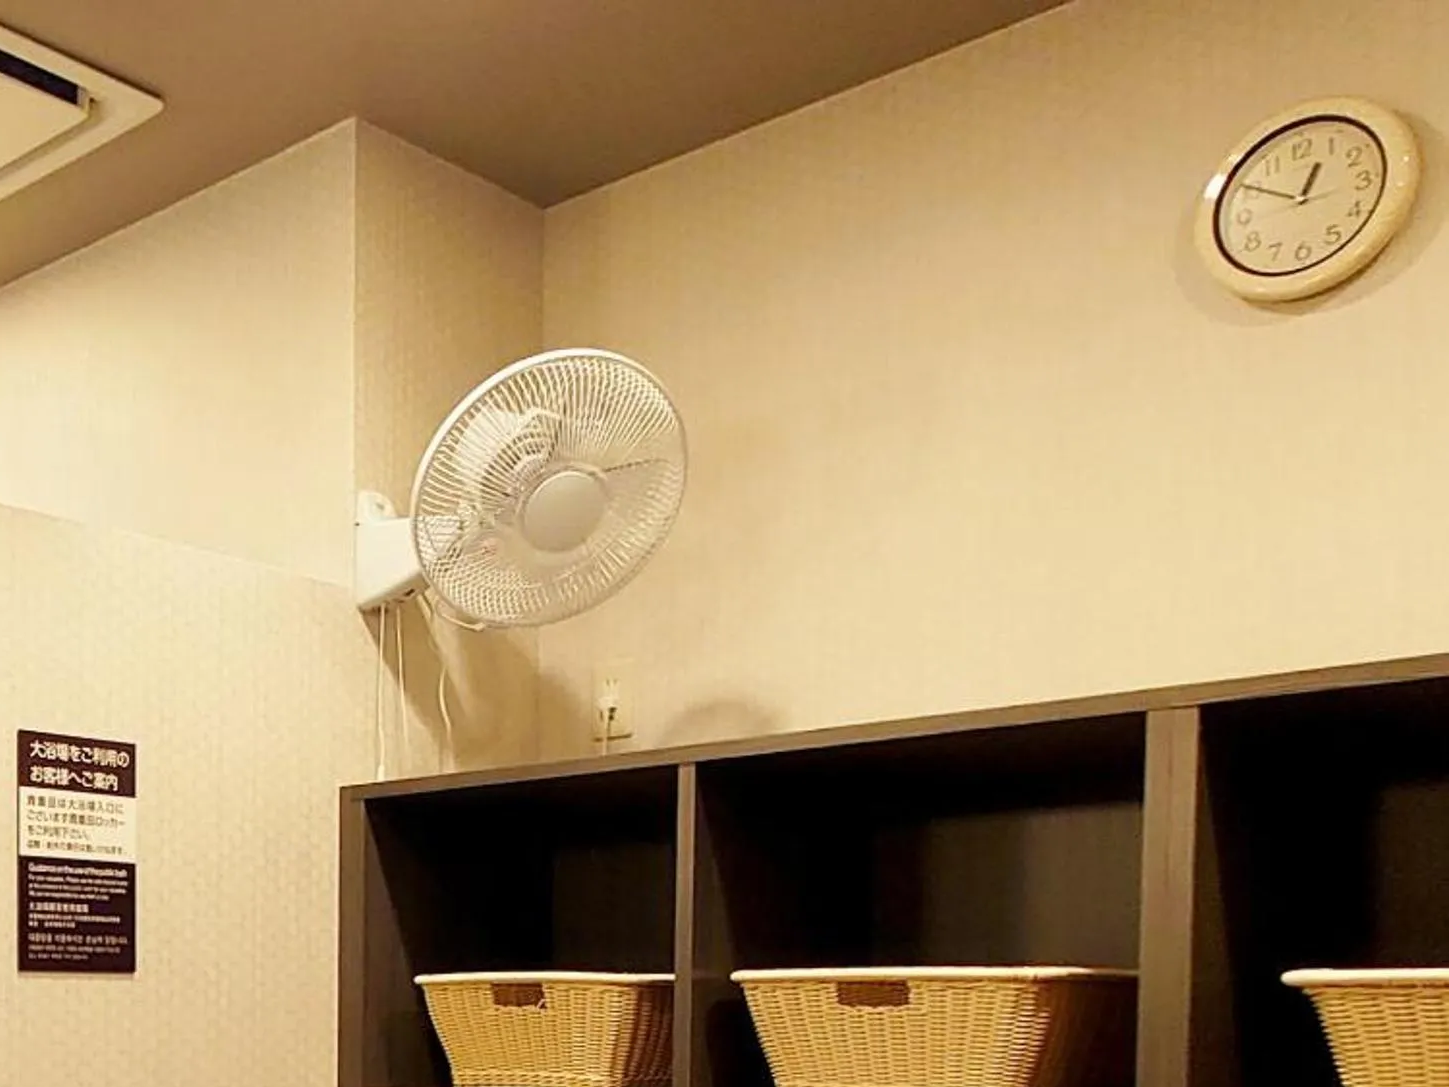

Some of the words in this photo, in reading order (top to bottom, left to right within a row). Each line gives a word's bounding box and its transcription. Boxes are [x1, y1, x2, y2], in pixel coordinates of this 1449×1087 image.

[1291, 138, 1313, 161] 12
[1328, 137, 1335, 155] 1
[1346, 146, 1362, 167] 2
[1355, 170, 1371, 190] 3
[1236, 208, 1253, 226] 9
[1346, 200, 1363, 218] 4
[1244, 231, 1262, 251] 8
[1324, 224, 1343, 245] 5
[1266, 242, 1283, 261] 7
[1294, 242, 1312, 261] 6
